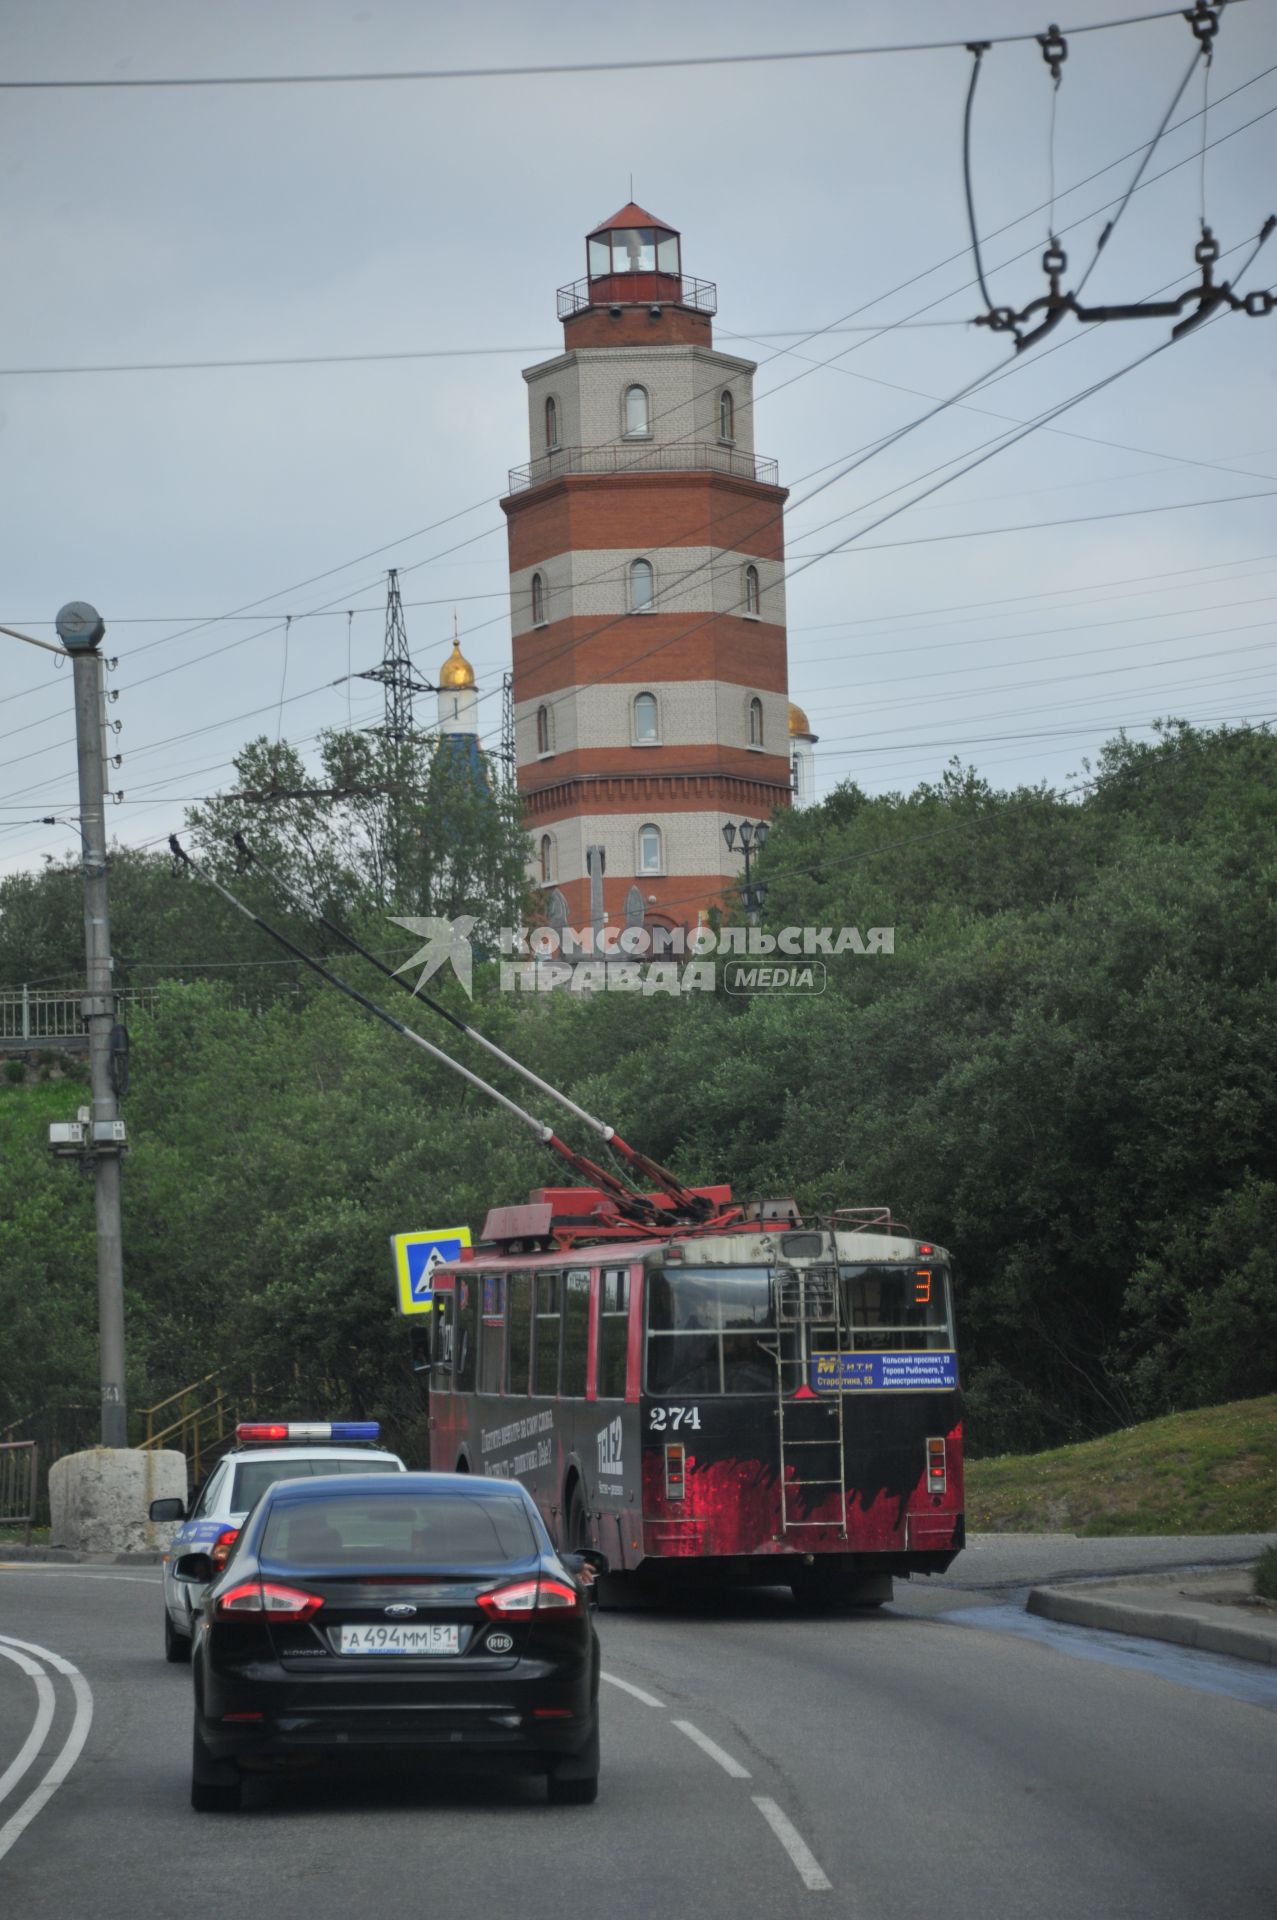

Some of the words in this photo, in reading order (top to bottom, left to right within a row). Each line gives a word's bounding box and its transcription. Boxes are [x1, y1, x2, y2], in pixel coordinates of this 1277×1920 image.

[916, 1270, 931, 1303] 3
[882, 1355, 913, 1365] Кольский
[883, 1366, 904, 1376] Героев
[817, 1376, 862, 1387] Старотина,
[650, 1406, 701, 1431] 274
[597, 1415, 623, 1475] TELE2
[490, 1637, 510, 1648] RUS
